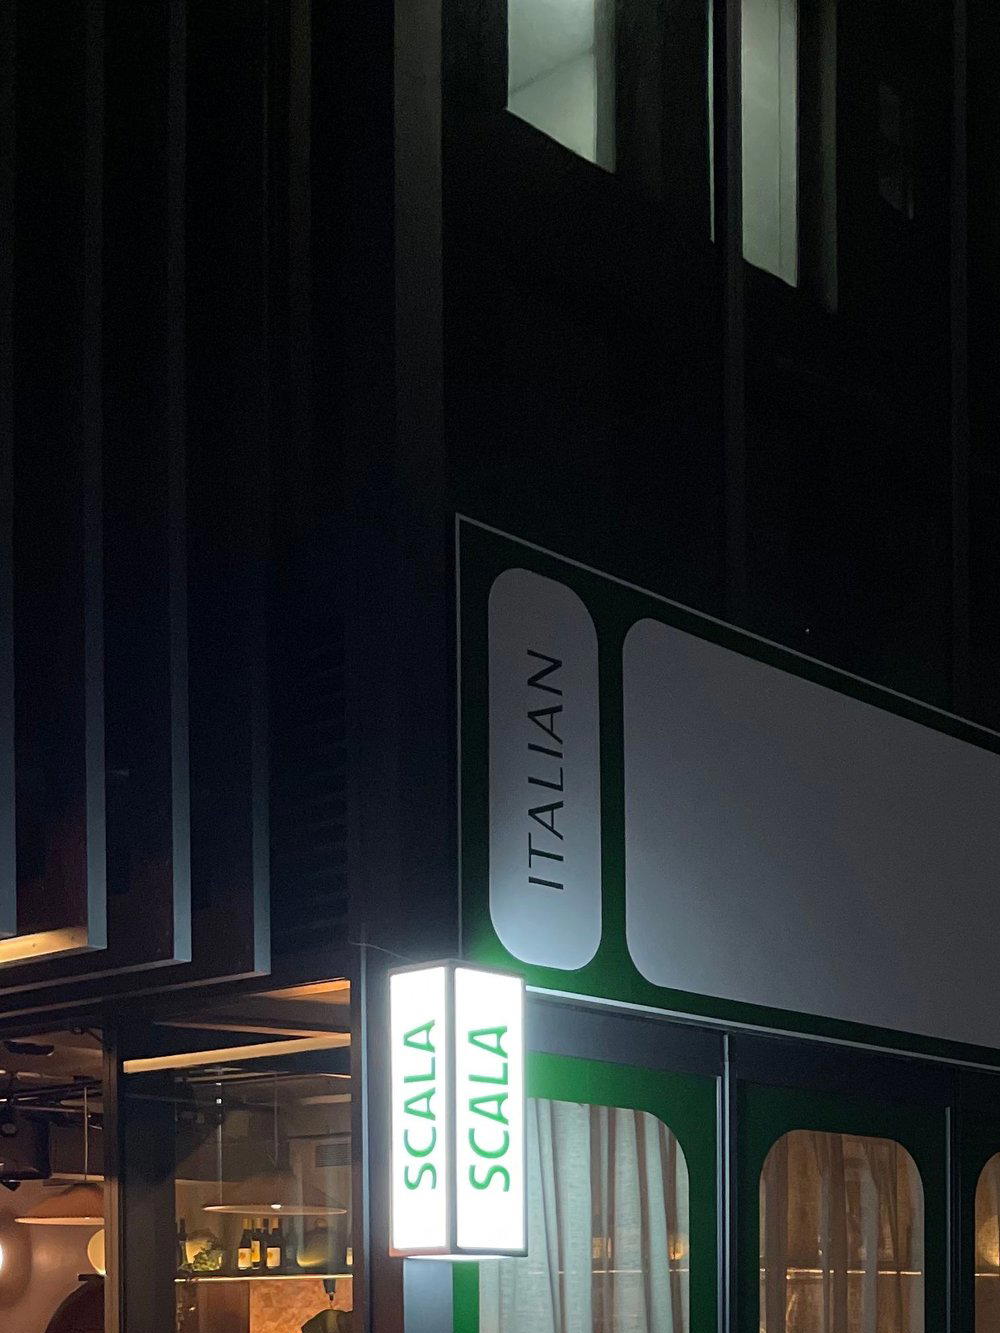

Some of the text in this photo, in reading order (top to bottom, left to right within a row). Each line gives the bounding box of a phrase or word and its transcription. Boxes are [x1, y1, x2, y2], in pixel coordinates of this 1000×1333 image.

[526, 648, 564, 890] ITALIAN
[403, 1019, 437, 1190] SCALA
[467, 1025, 511, 1192] SCALA
